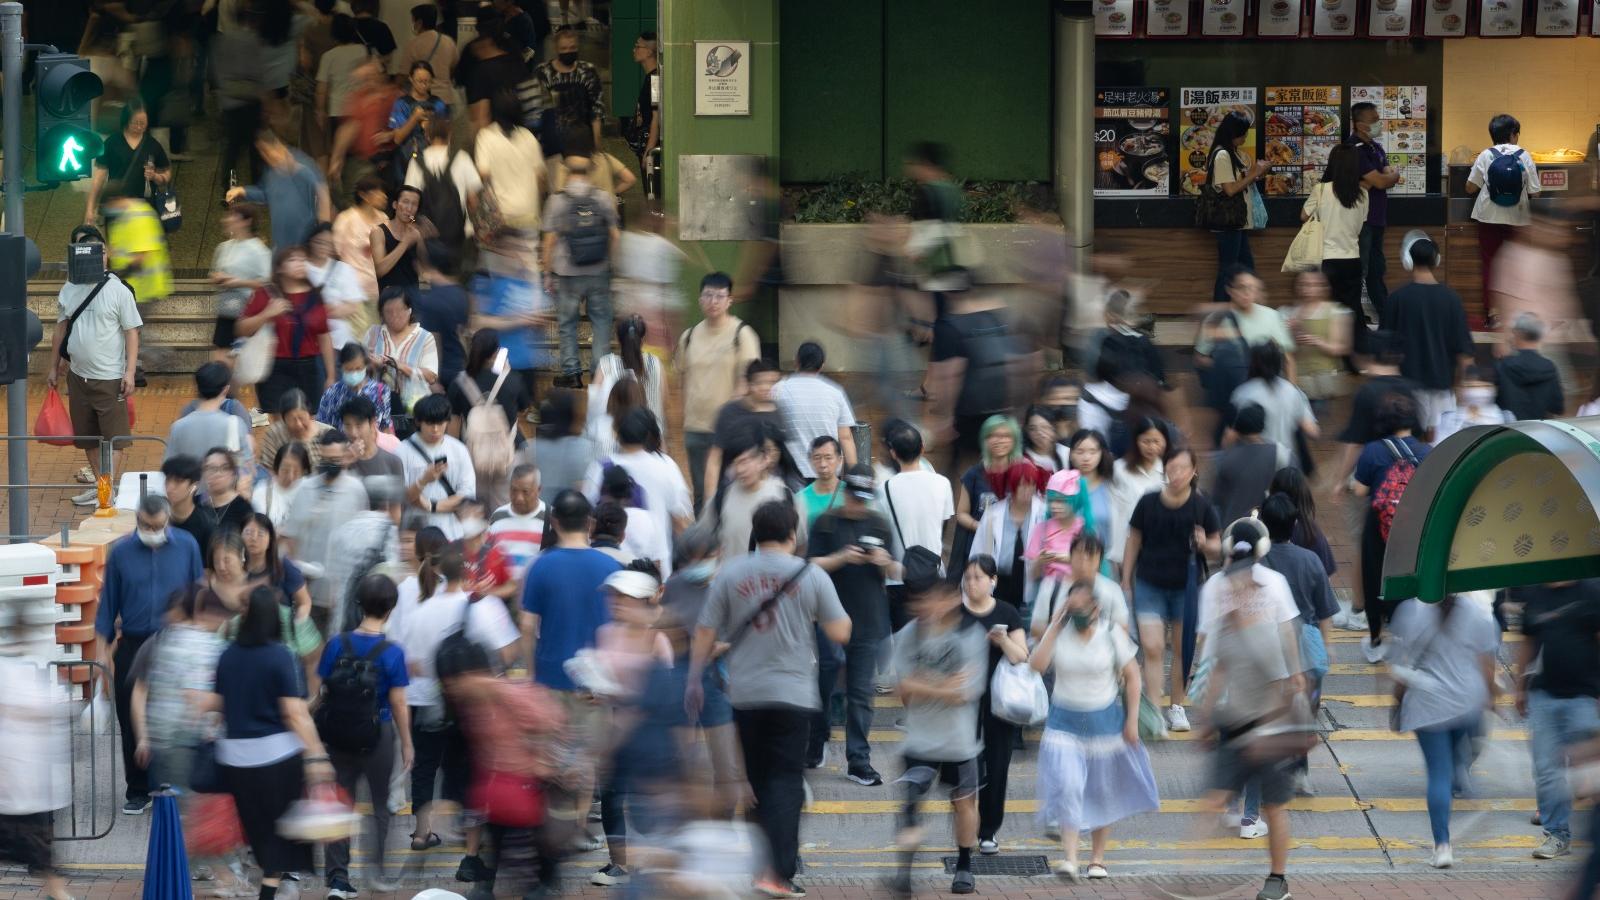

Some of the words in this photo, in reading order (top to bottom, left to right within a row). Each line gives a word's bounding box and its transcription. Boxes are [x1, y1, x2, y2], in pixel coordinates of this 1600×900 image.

[1103, 91, 1160, 104] 足料老火湯
[1275, 88, 1328, 102] 家常飯餸
[1094, 129, 1115, 142] $20
